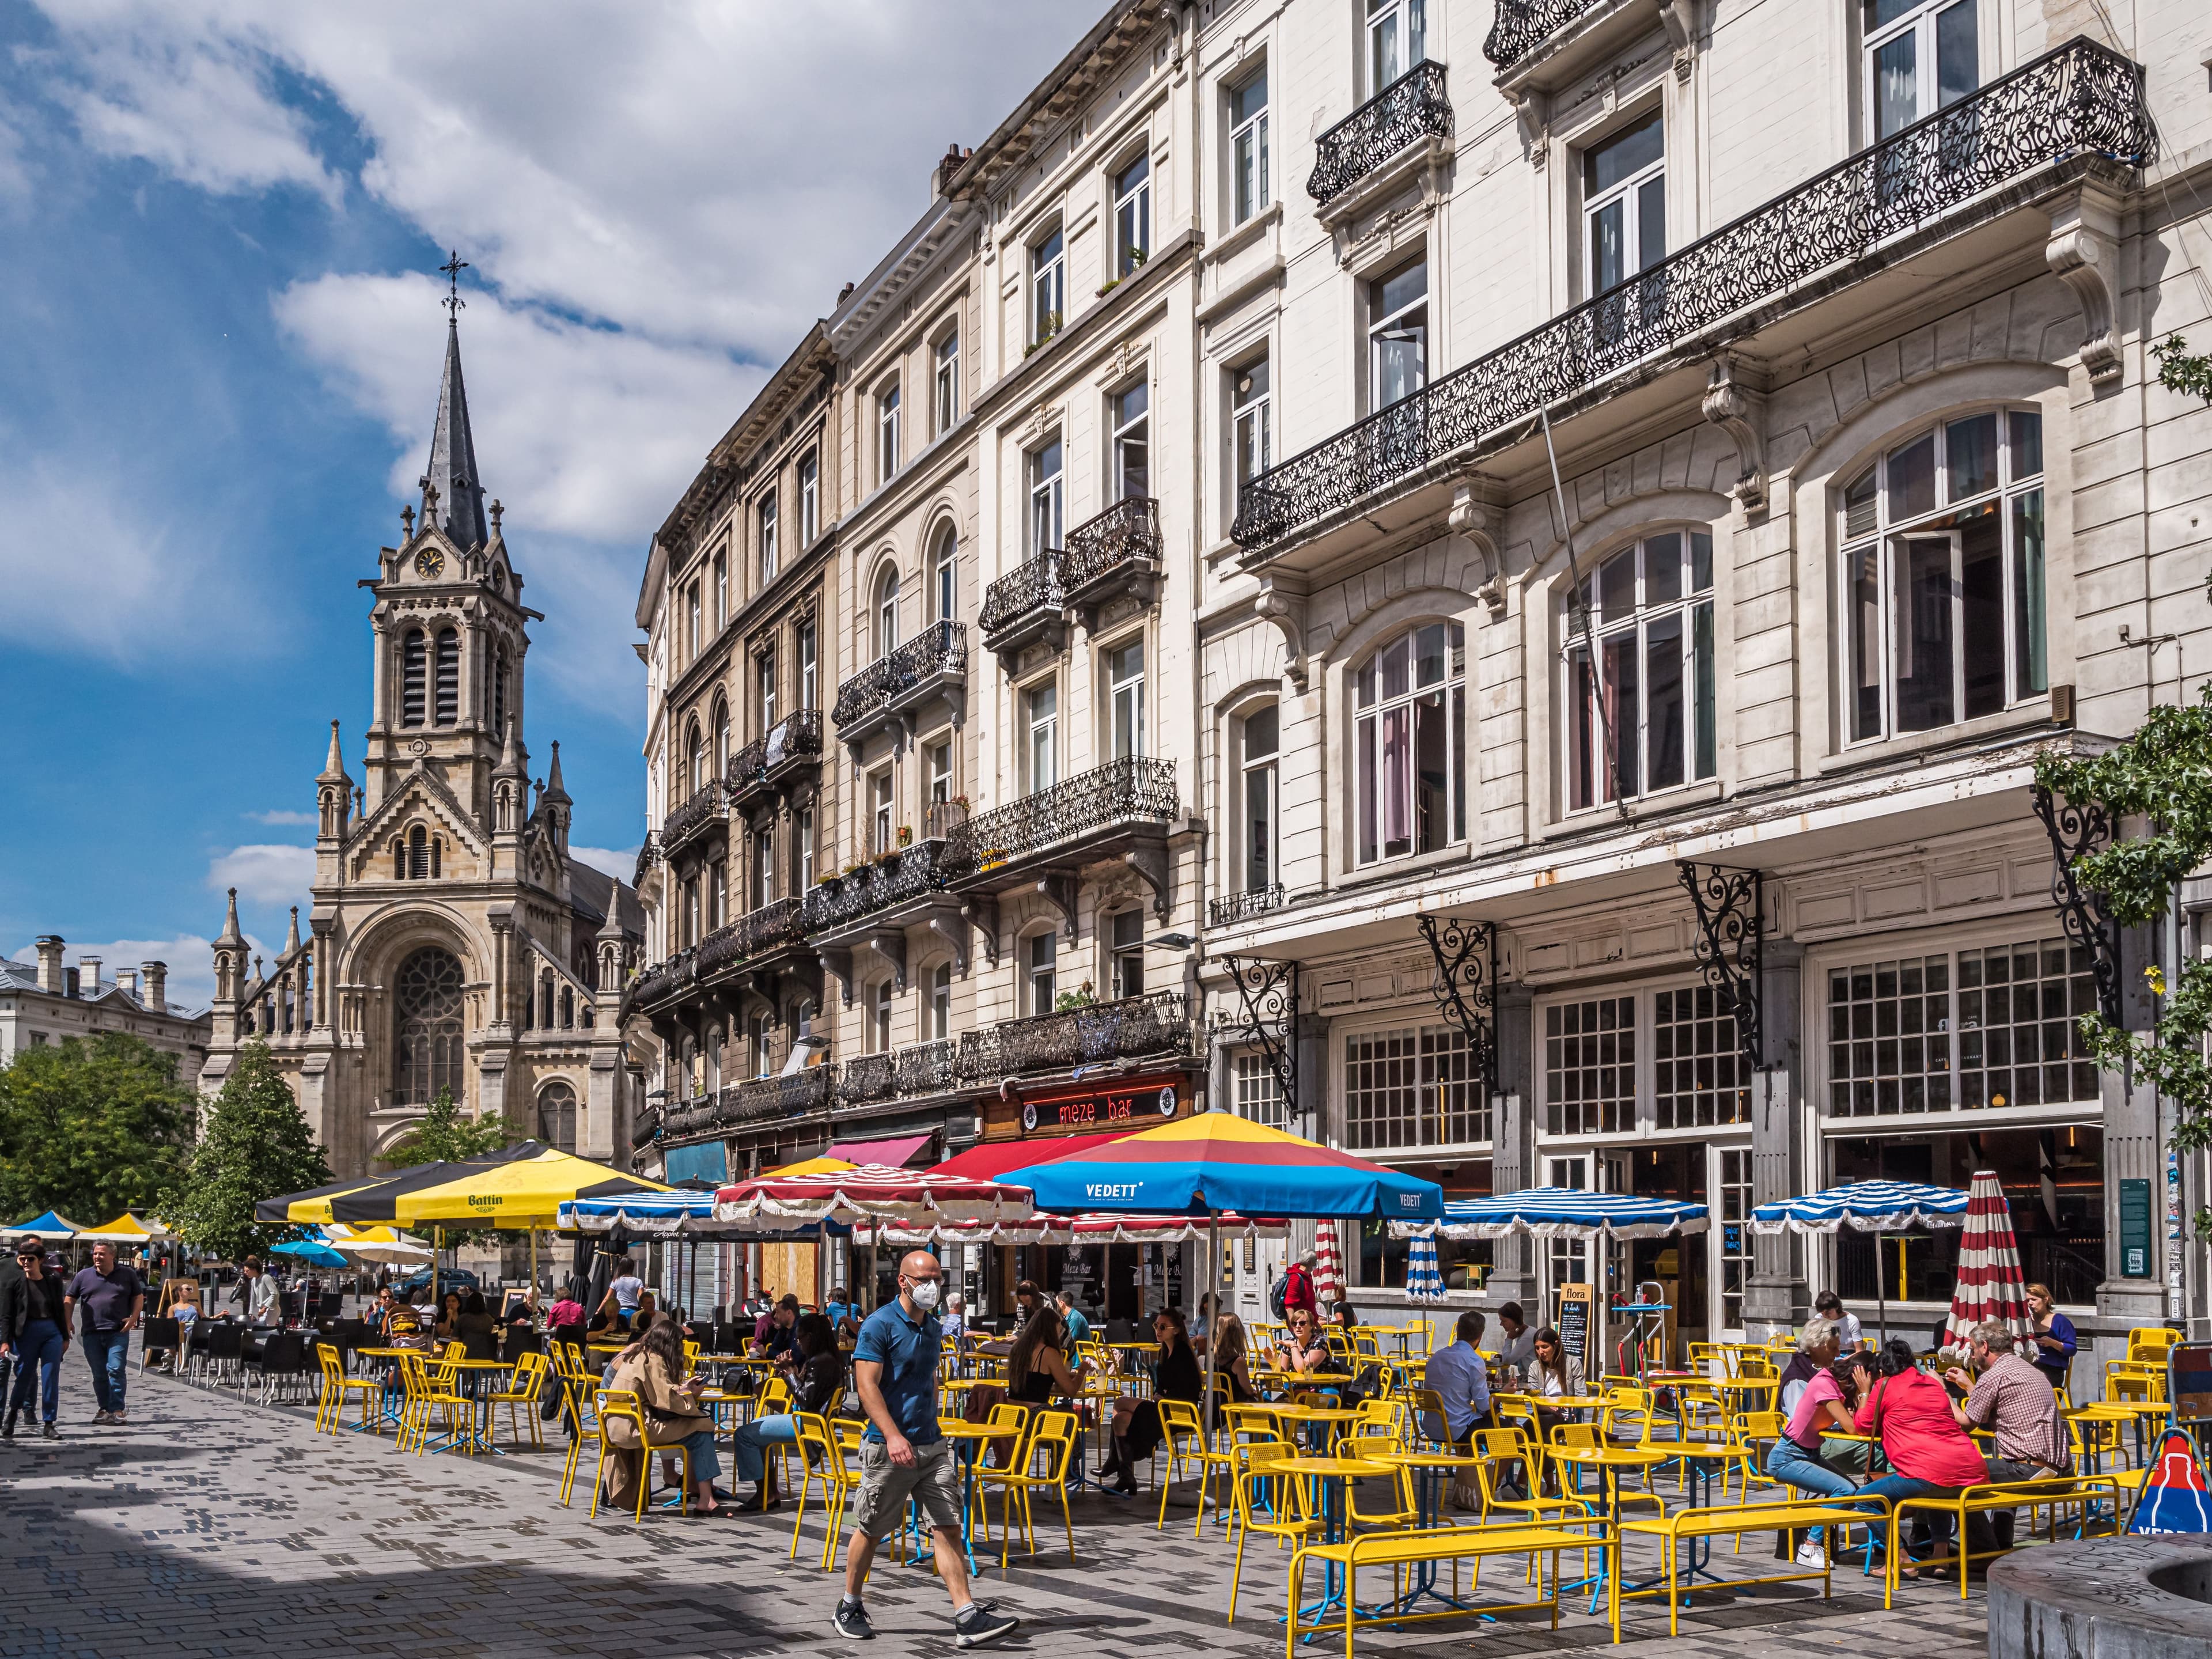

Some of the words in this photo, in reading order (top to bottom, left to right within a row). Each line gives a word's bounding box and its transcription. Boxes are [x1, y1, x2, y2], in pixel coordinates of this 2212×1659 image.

[1059, 1103, 1094, 1124] meze
[1108, 1096, 1132, 1120] bar
[1086, 1184, 1137, 1197] VEDETT
[468, 1195, 503, 1206] Battin
[1400, 1194, 1420, 1207] VEDETT
[1063, 1263, 1078, 1274] Meze
[1080, 1263, 1092, 1274] Bar
[1566, 1288, 1585, 1298] flora
